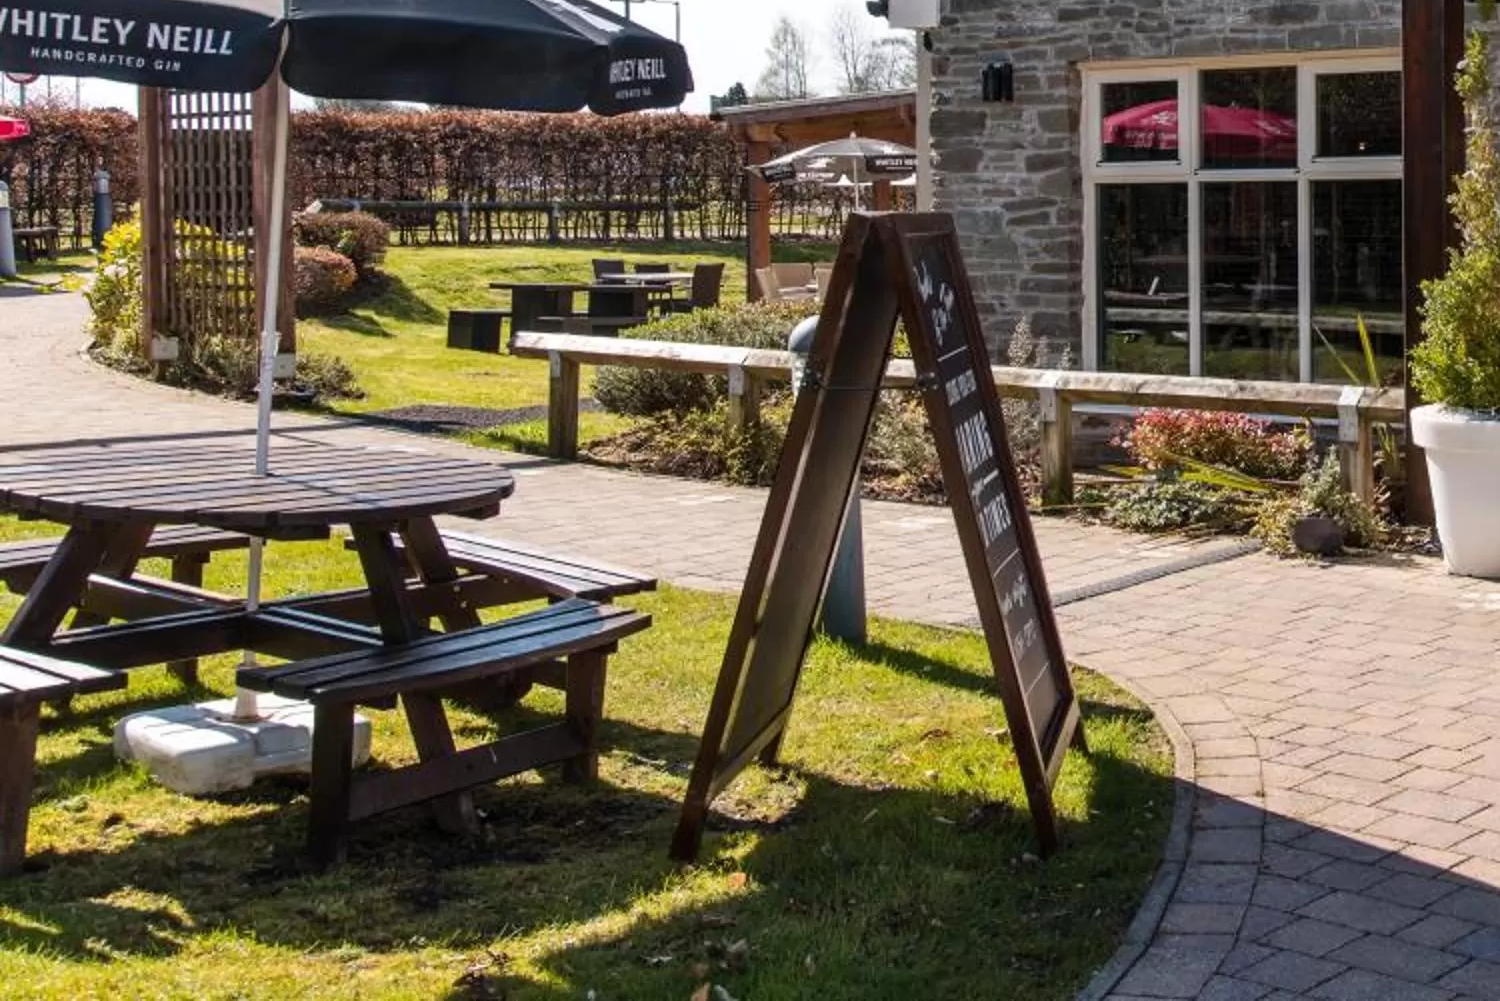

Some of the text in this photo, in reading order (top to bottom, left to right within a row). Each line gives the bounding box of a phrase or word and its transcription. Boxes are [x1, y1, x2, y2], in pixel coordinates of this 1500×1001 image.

[147, 22, 233, 55] NEILL
[30, 47, 181, 72] HANDCRAFTED GIN
[637, 58, 666, 80] NEILL
